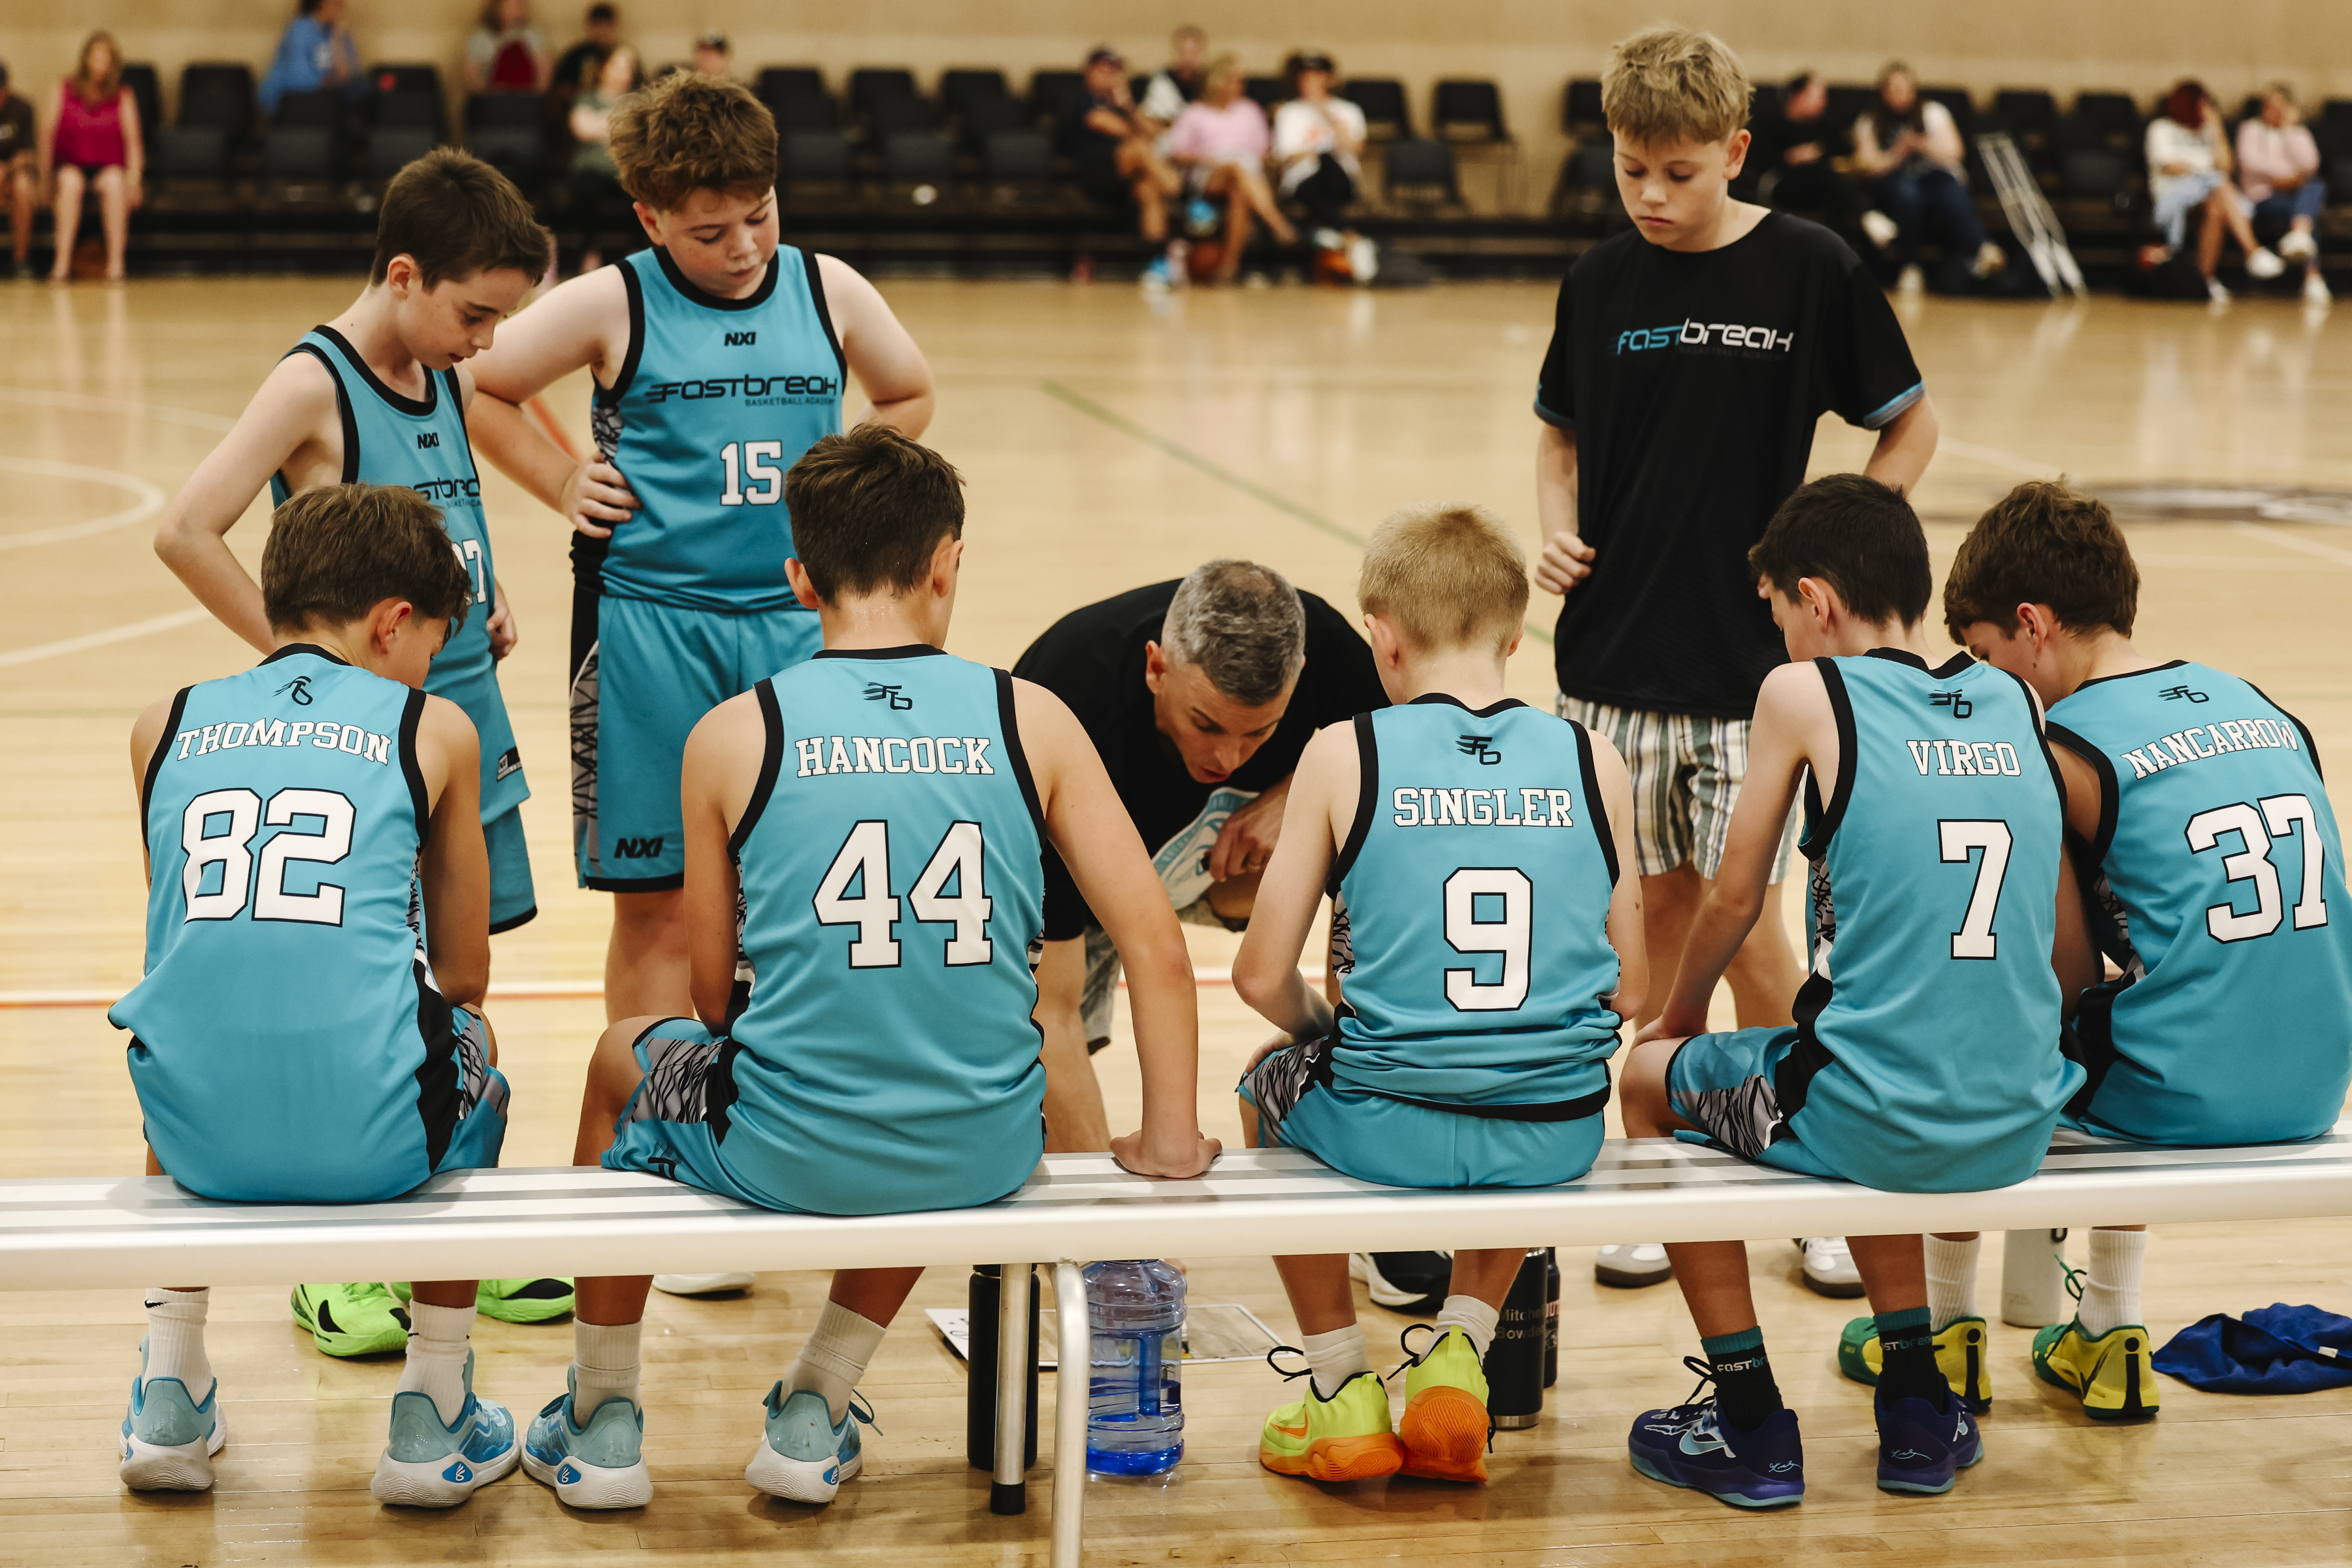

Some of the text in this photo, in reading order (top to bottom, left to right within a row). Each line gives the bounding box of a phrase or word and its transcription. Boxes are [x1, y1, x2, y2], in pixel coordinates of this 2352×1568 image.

[725, 332, 756, 346] NXI
[745, 397, 803, 406] BASKETBALL
[720, 440, 783, 506] 15
[177, 717, 392, 766] THOMPSON
[795, 736, 994, 777] HANCOCK
[1906, 739, 2021, 777] VIRGO
[2121, 719, 2298, 780] NANCARROW
[1392, 787, 1574, 827] SINGLER
[181, 787, 357, 928] 82
[614, 837, 664, 858] NXI
[2184, 793, 2328, 944] 37
[811, 819, 993, 970] 44
[1936, 819, 2014, 960] 7
[1443, 866, 1533, 1012] 9
